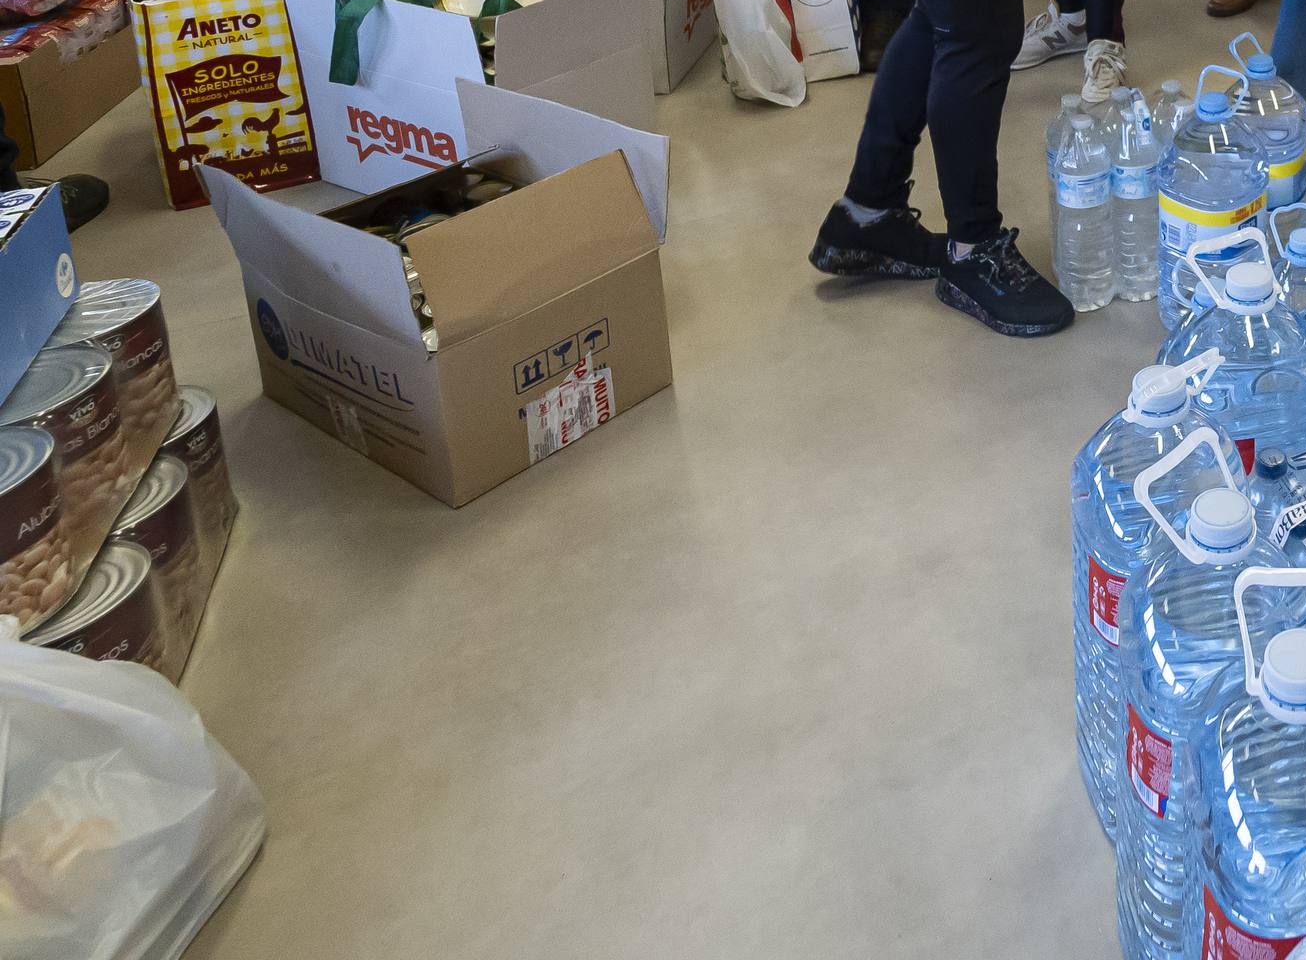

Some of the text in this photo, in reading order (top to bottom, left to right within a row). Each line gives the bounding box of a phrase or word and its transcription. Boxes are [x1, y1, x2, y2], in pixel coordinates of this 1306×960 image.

[176, 12, 262, 41] ANETO
[192, 32, 253, 50] NATURAL
[181, 71, 276, 97] INGREDIENTES
[194, 60, 259, 84] SOLO
[185, 91, 223, 105] FRESCOS
[229, 82, 275, 96] NATURALES
[346, 105, 458, 163] regma
[260, 162, 288, 177] MÁS
[593, 376, 611, 425] MUITO
